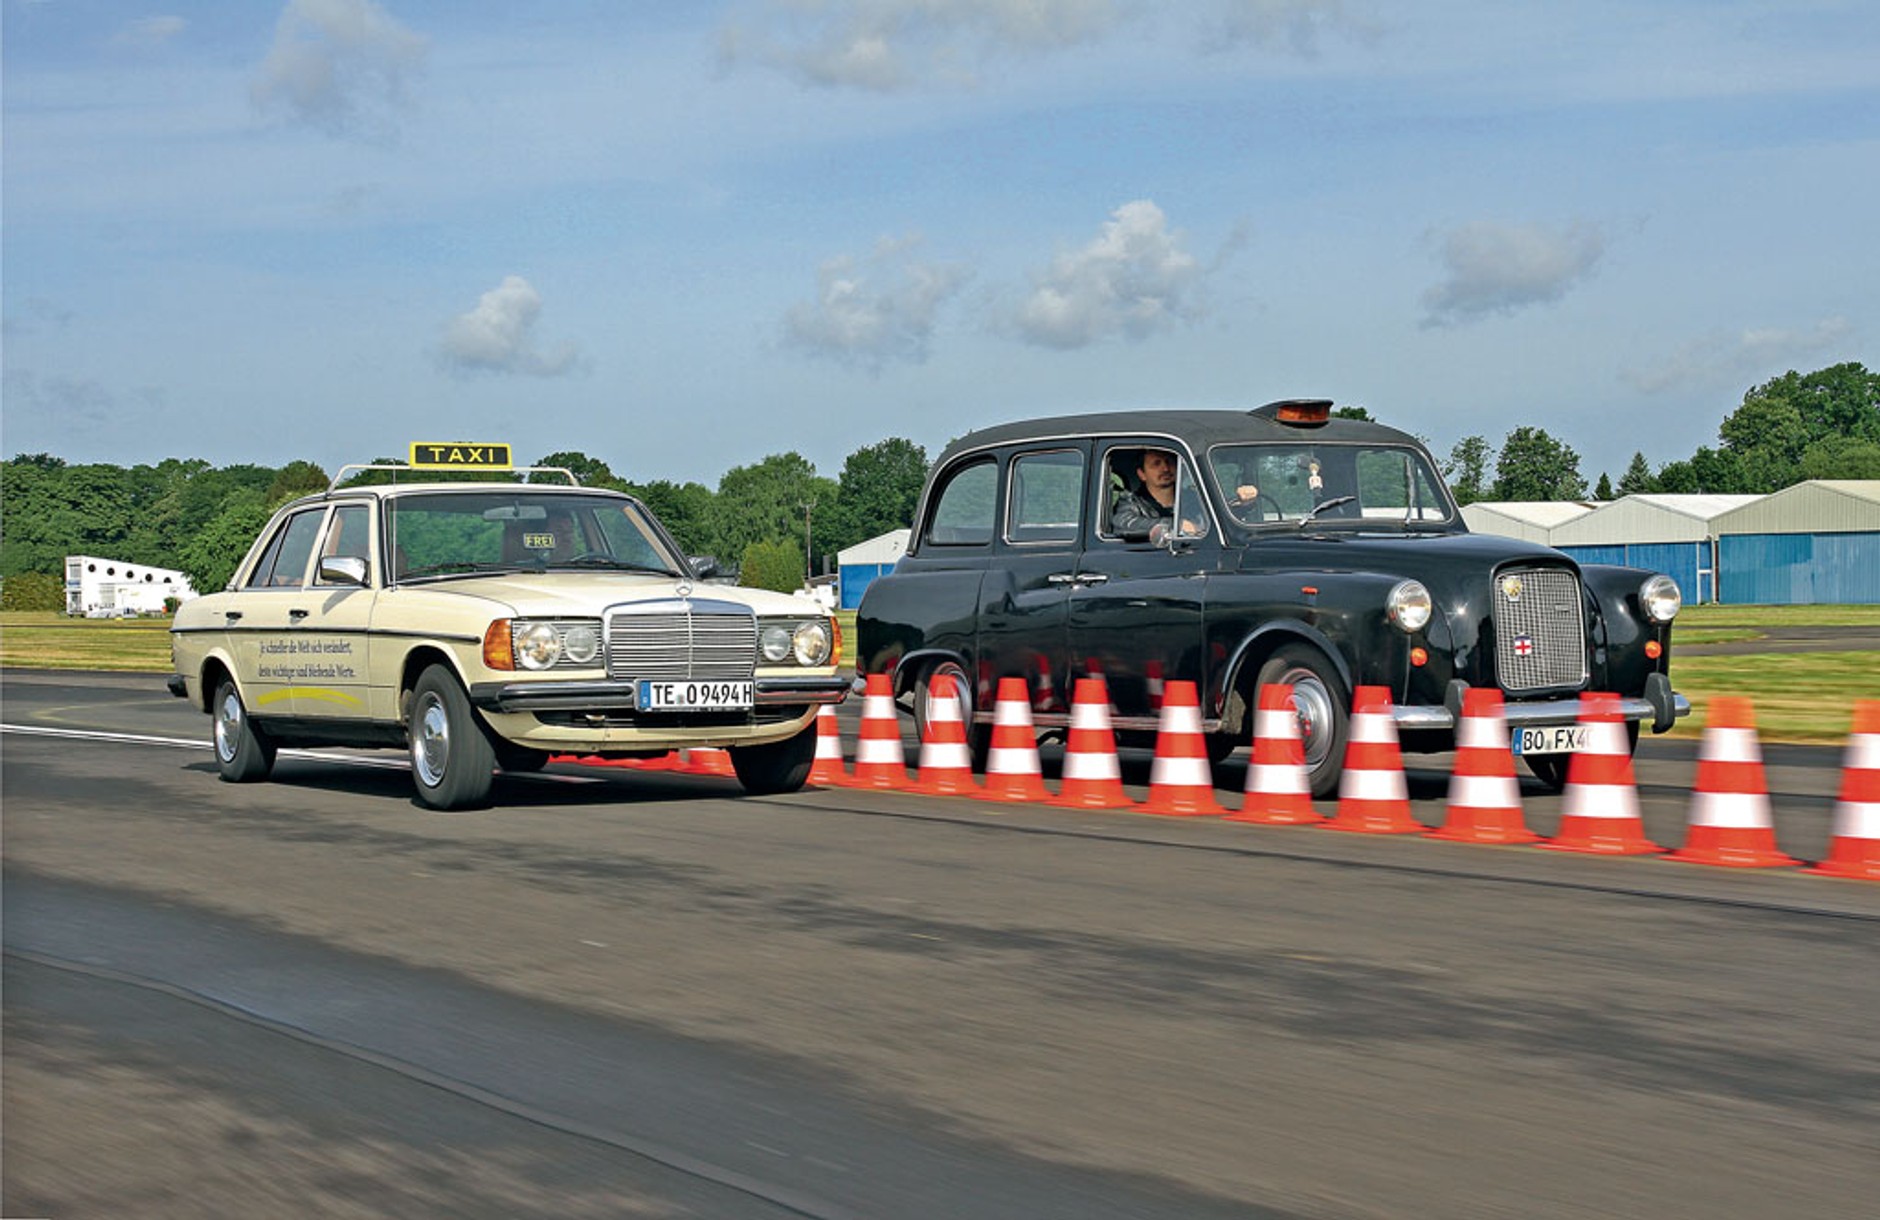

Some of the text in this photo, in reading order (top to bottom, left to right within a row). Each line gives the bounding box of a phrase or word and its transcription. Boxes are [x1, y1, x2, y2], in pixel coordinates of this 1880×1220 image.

[428, 447, 494, 462] TAXI
[526, 535, 553, 547] FREI
[652, 684, 675, 705] TE
